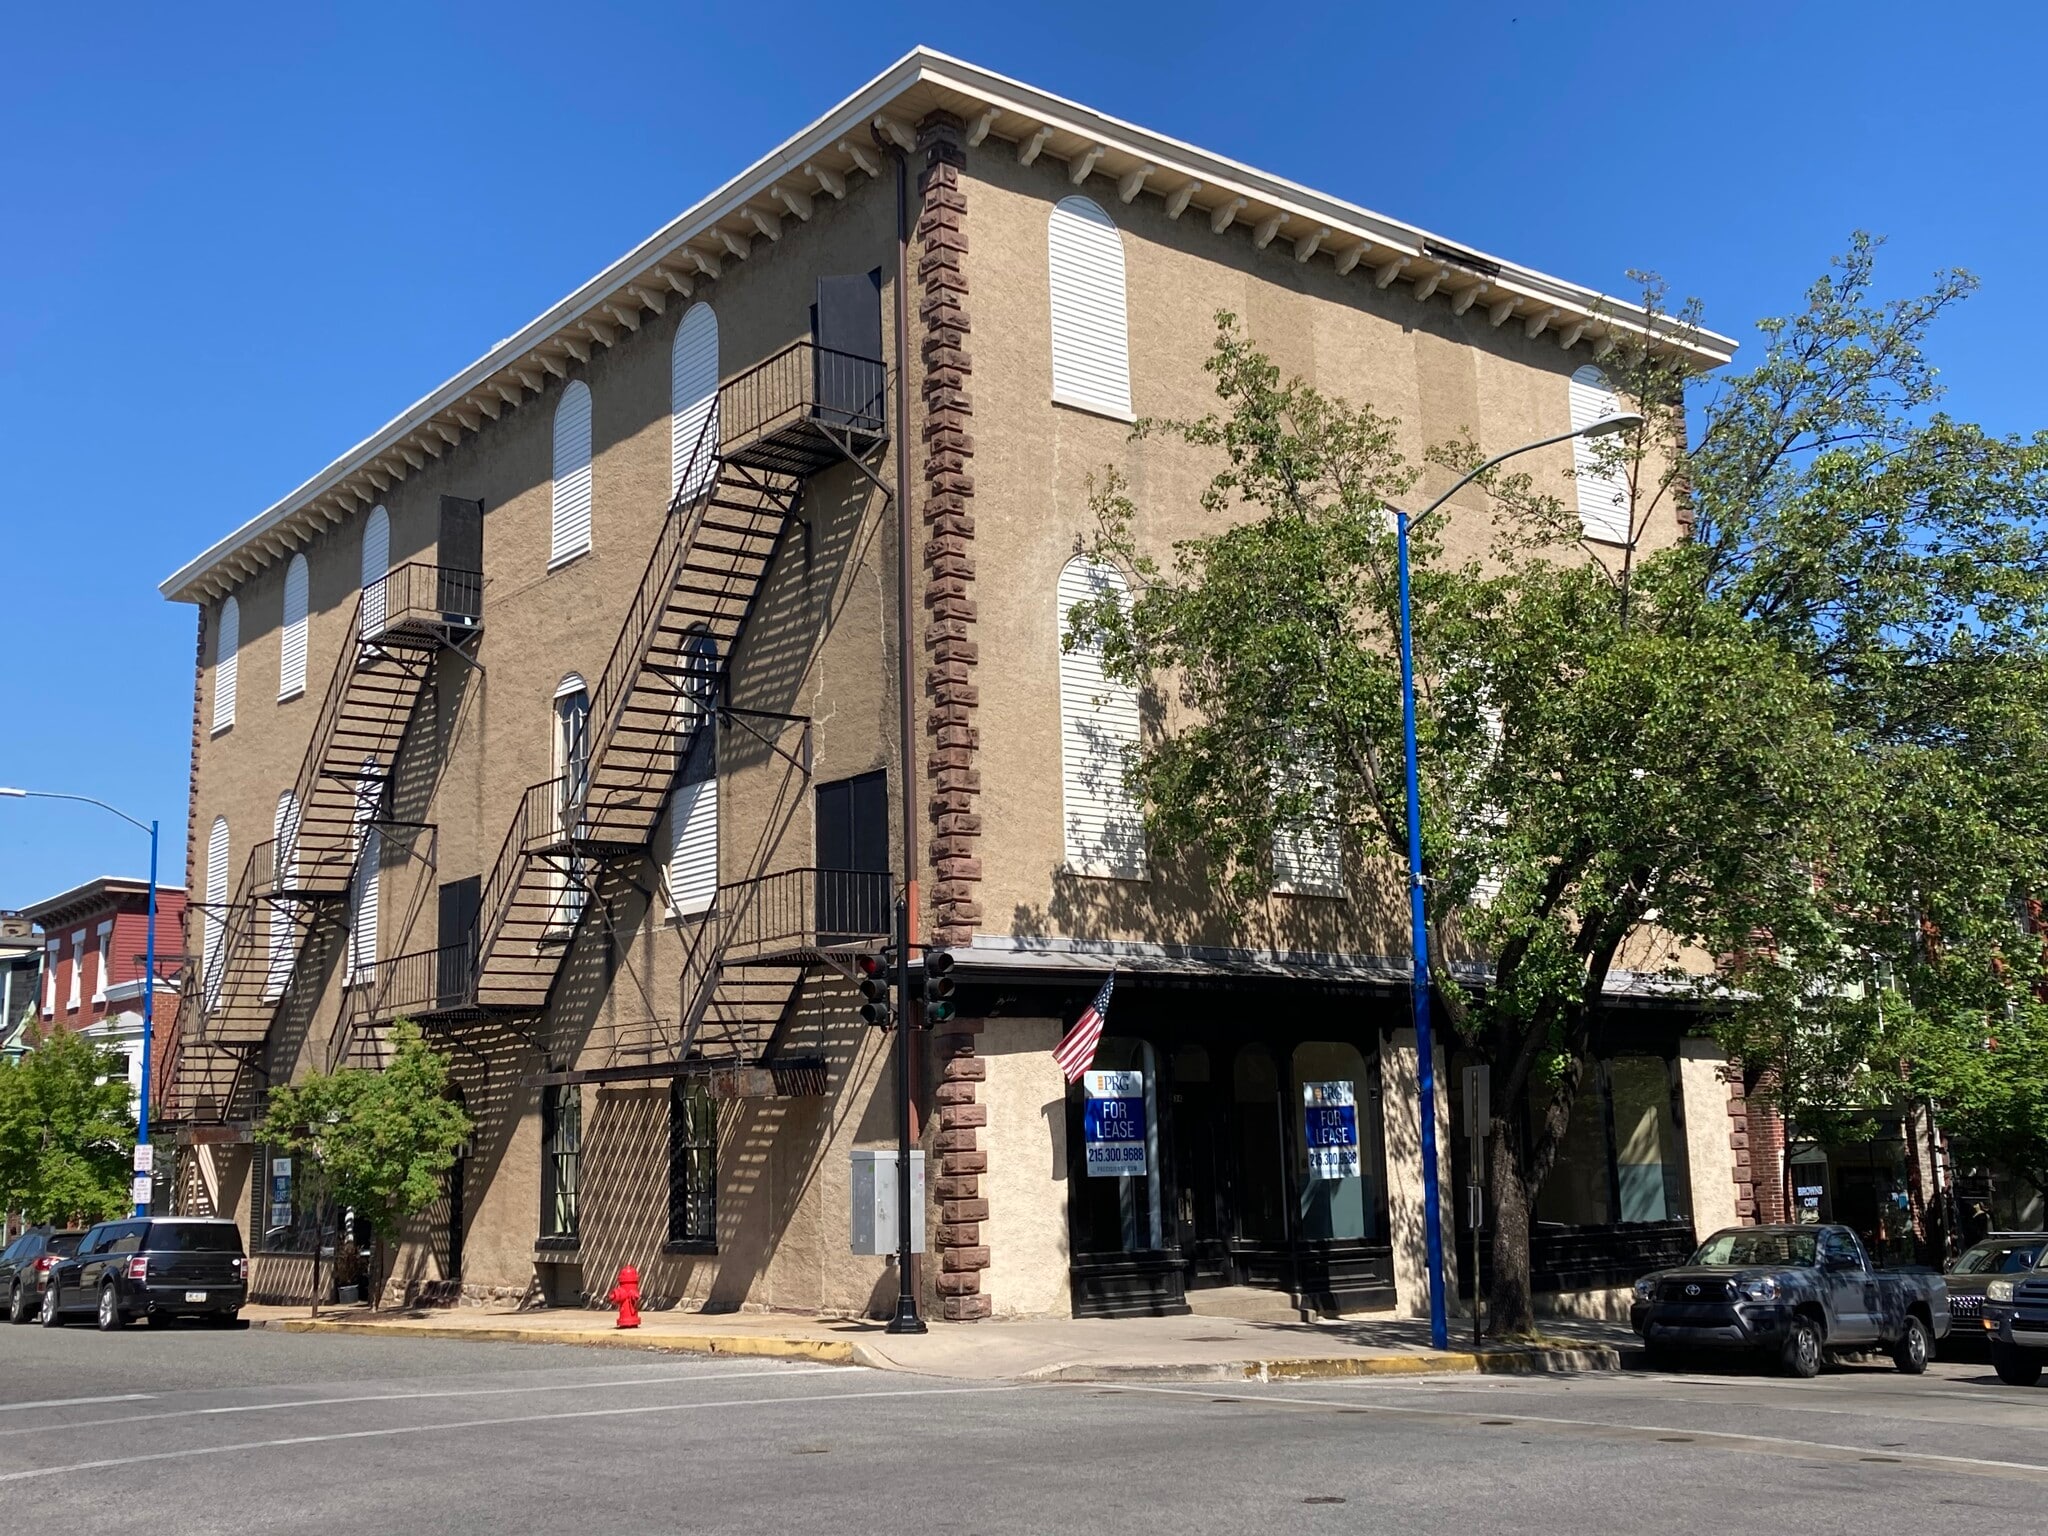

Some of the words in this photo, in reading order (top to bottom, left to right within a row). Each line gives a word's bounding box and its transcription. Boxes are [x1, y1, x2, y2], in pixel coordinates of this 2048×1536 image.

[1103, 1075, 1129, 1091] PRG
[1103, 1101, 1127, 1119] FOR
[1320, 1109, 1342, 1126] FOR
[1096, 1120, 1135, 1139] LEASE
[1316, 1127, 1350, 1145] LEASE
[1088, 1147, 1144, 1162] 215.300.9688
[1804, 1197, 1818, 1207] COW
